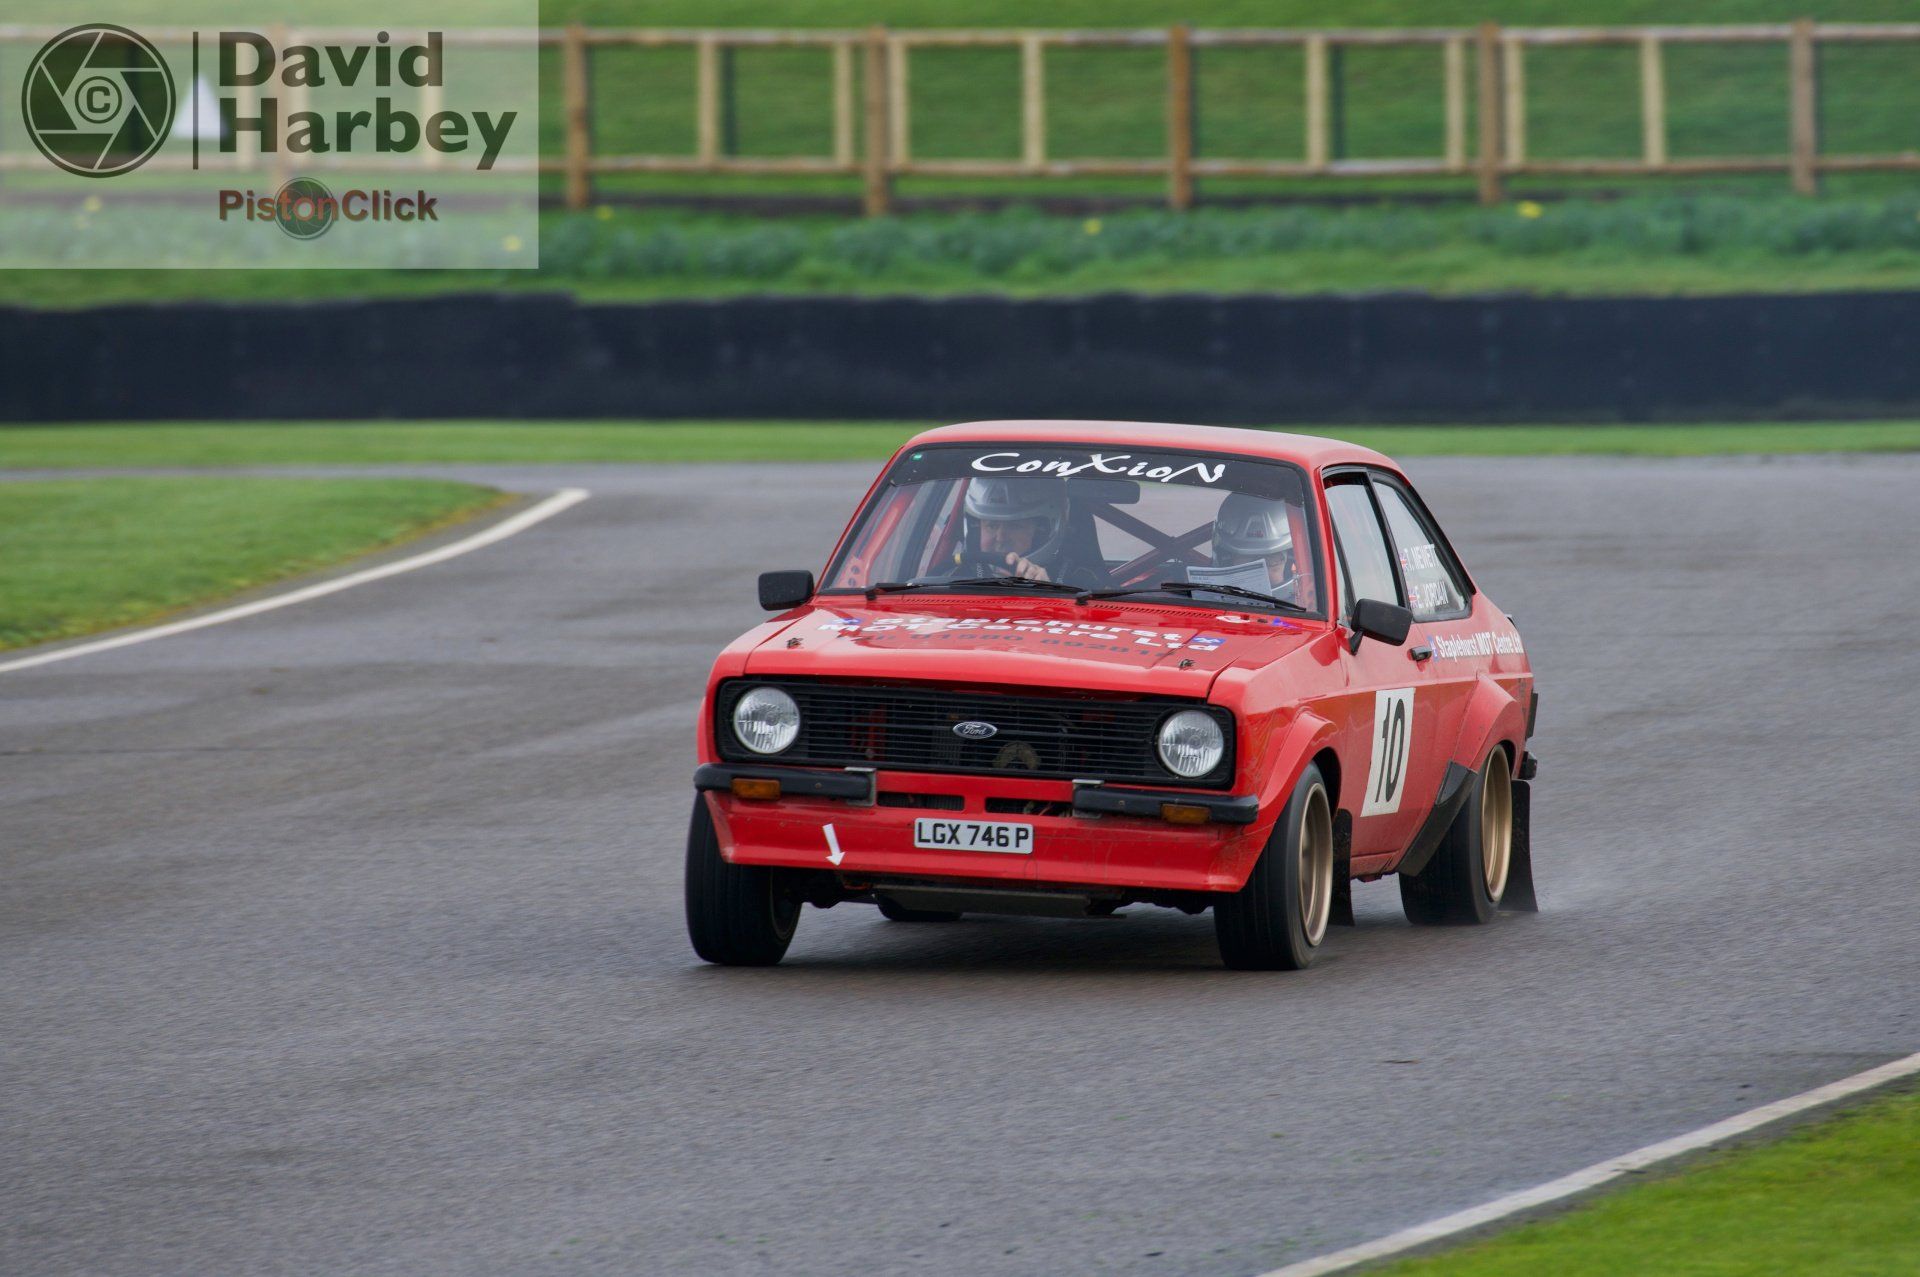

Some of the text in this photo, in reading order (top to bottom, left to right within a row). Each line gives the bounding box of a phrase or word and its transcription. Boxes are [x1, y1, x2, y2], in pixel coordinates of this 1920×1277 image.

[817, 624, 1218, 651] MOT Centre Ltd
[1435, 632, 1480, 662] Staplehurst
[1475, 631, 1494, 655] MOT
[962, 723, 987, 736] Ford
[1375, 697, 1406, 802] 10
[917, 821, 961, 845] LGX
